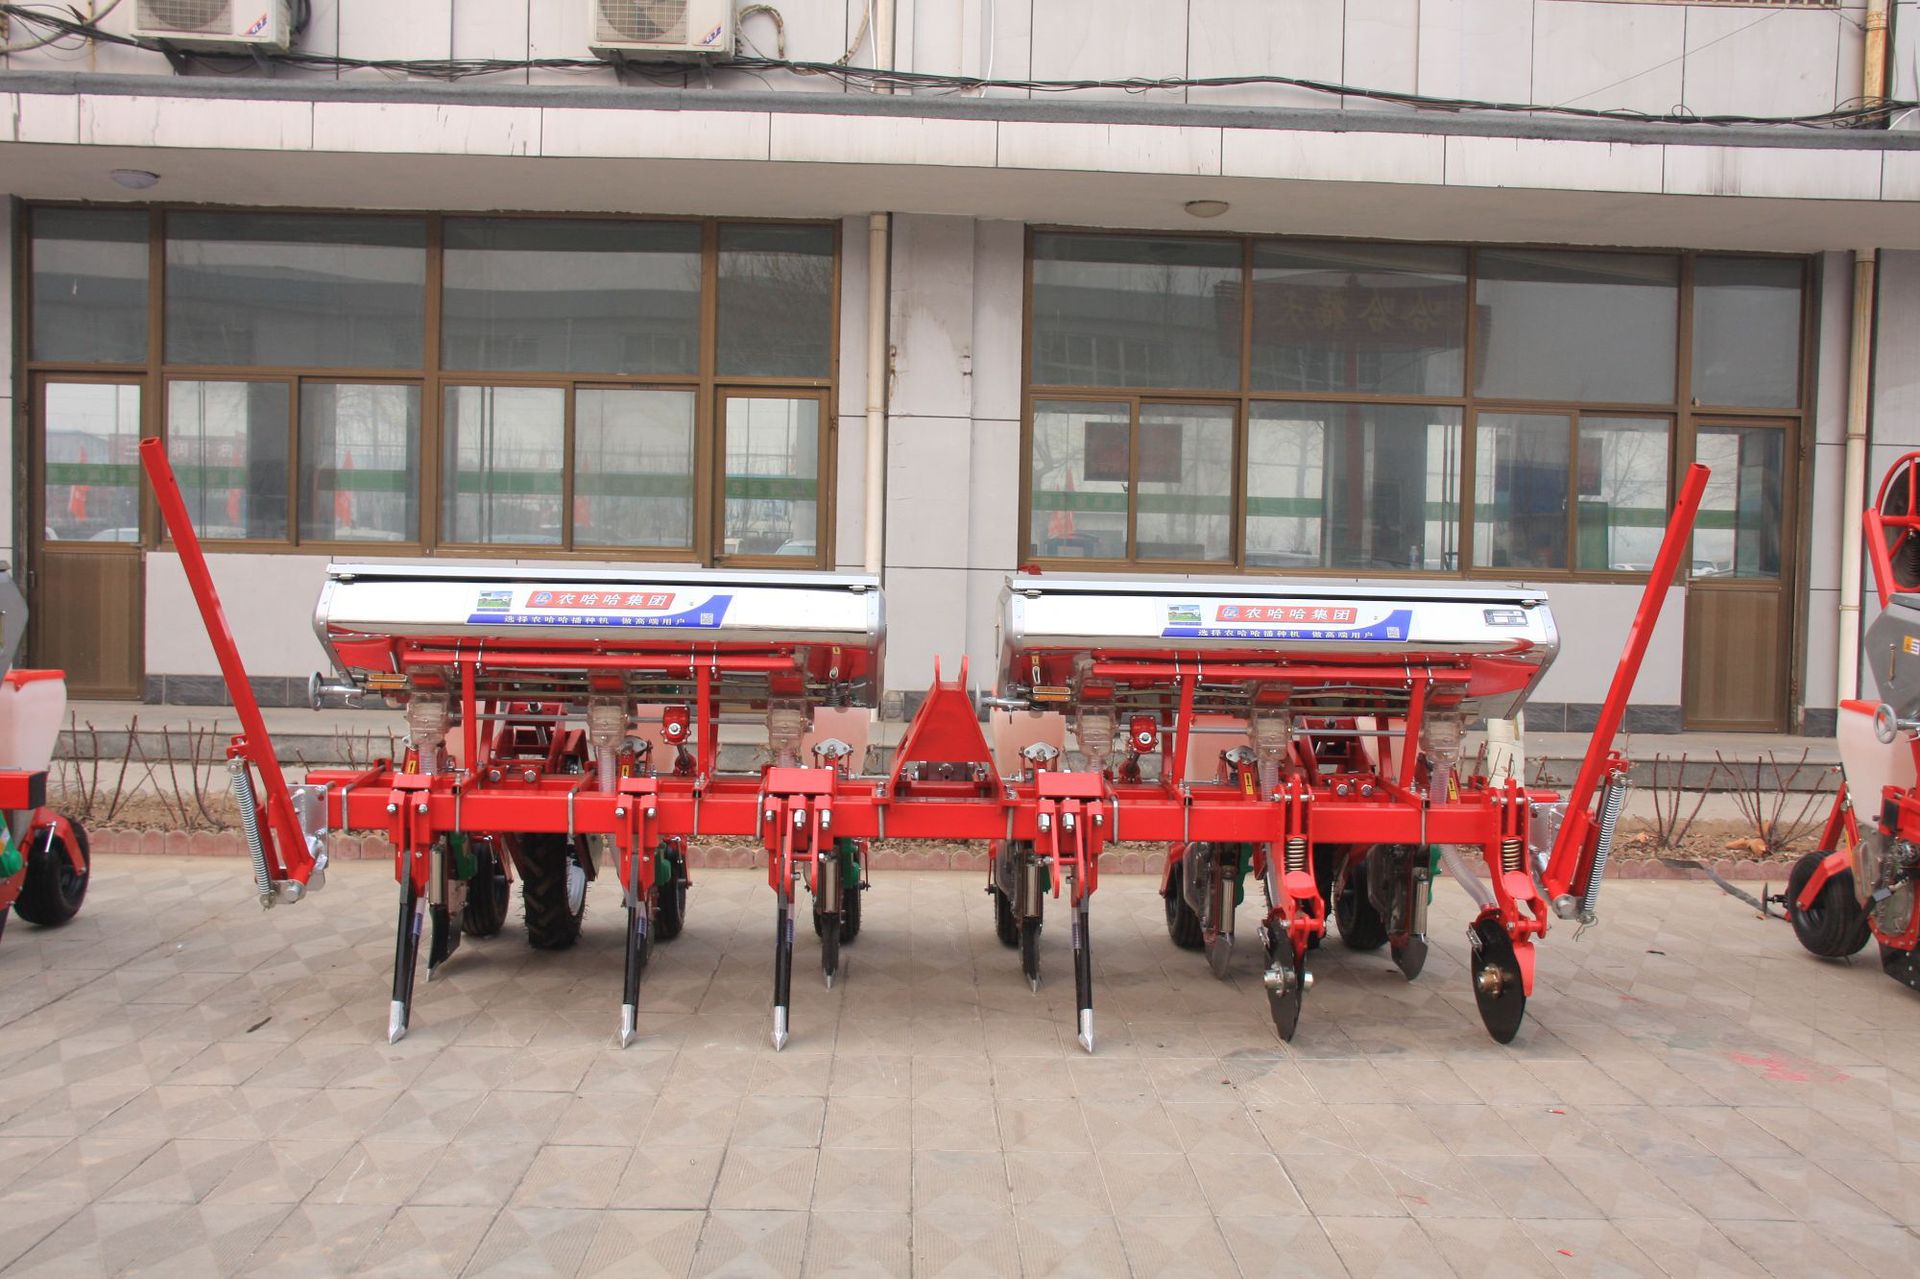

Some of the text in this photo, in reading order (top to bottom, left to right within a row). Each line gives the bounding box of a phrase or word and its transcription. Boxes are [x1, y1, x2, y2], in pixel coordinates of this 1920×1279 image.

[556, 593, 668, 606] 农哈哈集团
[504, 615, 609, 625] 选择农哈哈播种机
[1244, 607, 1351, 620] 农哈哈集团
